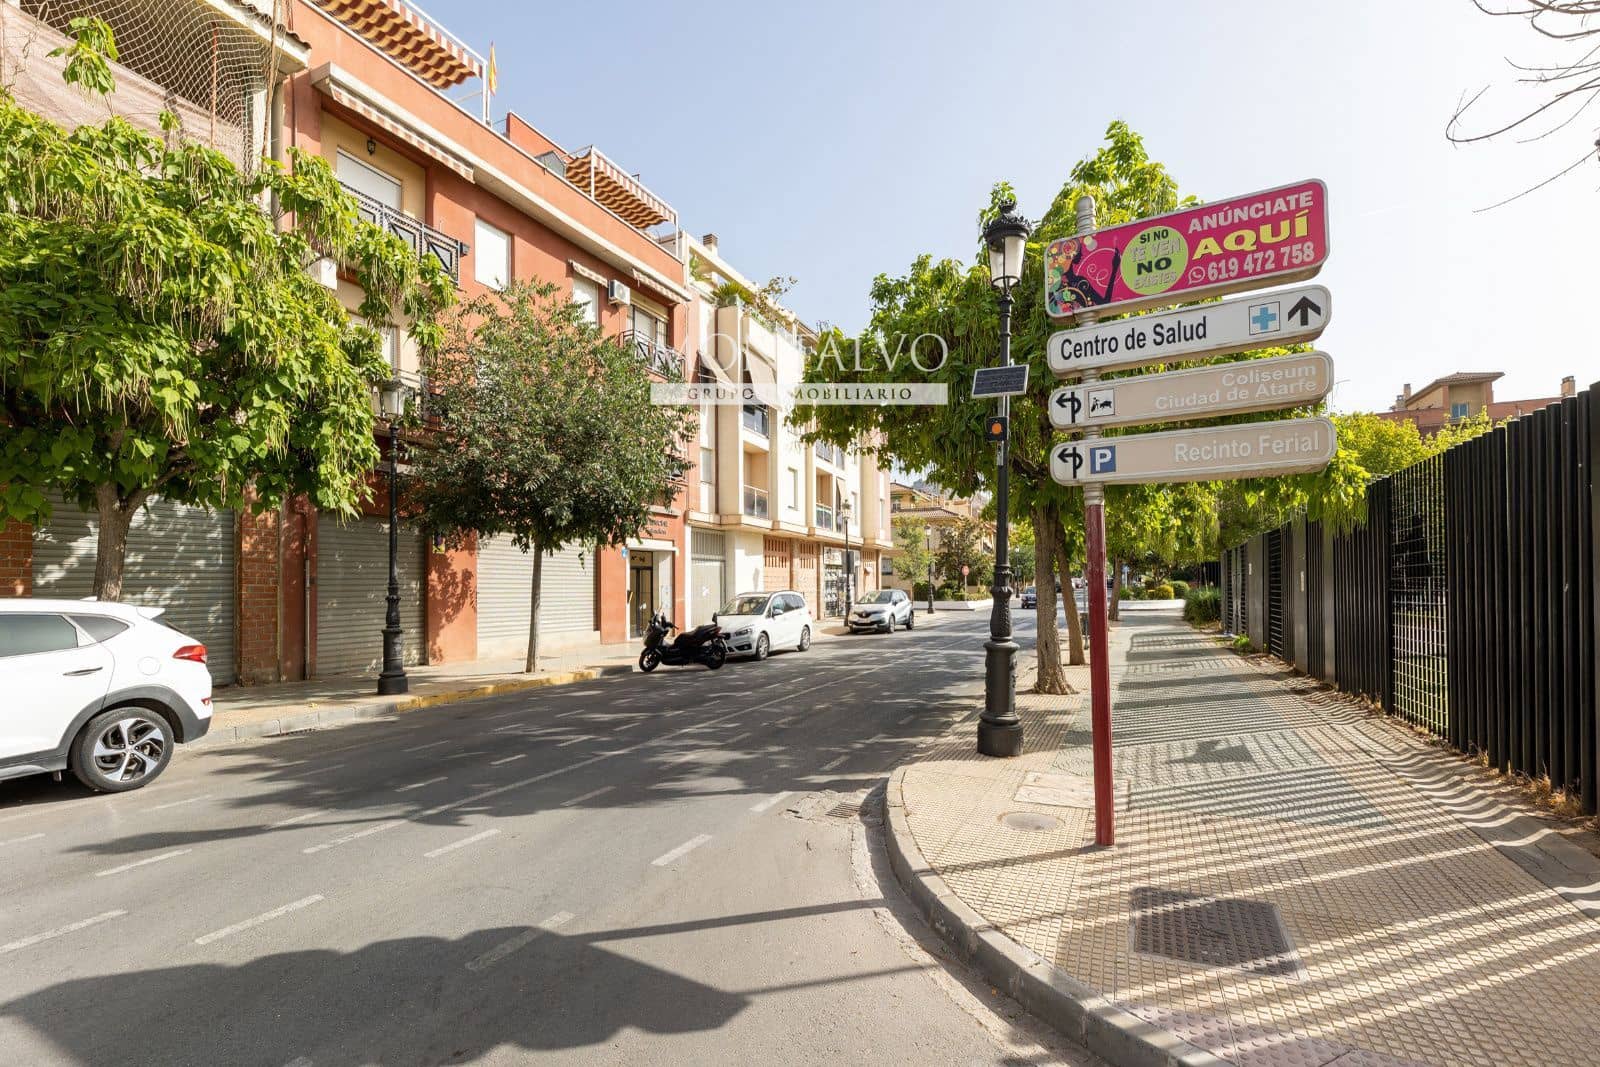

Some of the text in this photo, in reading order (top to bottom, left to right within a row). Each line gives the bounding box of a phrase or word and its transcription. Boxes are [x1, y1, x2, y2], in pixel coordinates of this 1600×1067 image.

[1188, 191, 1313, 233] ANÚNCIATE
[1140, 229, 1169, 245] SI NO
[1192, 210, 1311, 260] AQUÍ
[1137, 256, 1172, 275] NO
[1207, 241, 1315, 282] 619 472 758
[1060, 315, 1208, 361] Centro de Salud
[1221, 363, 1317, 388] Coliseum
[1155, 379, 1317, 411] Ciudad de Atarfe
[1175, 430, 1320, 464] Recinto Ferial
